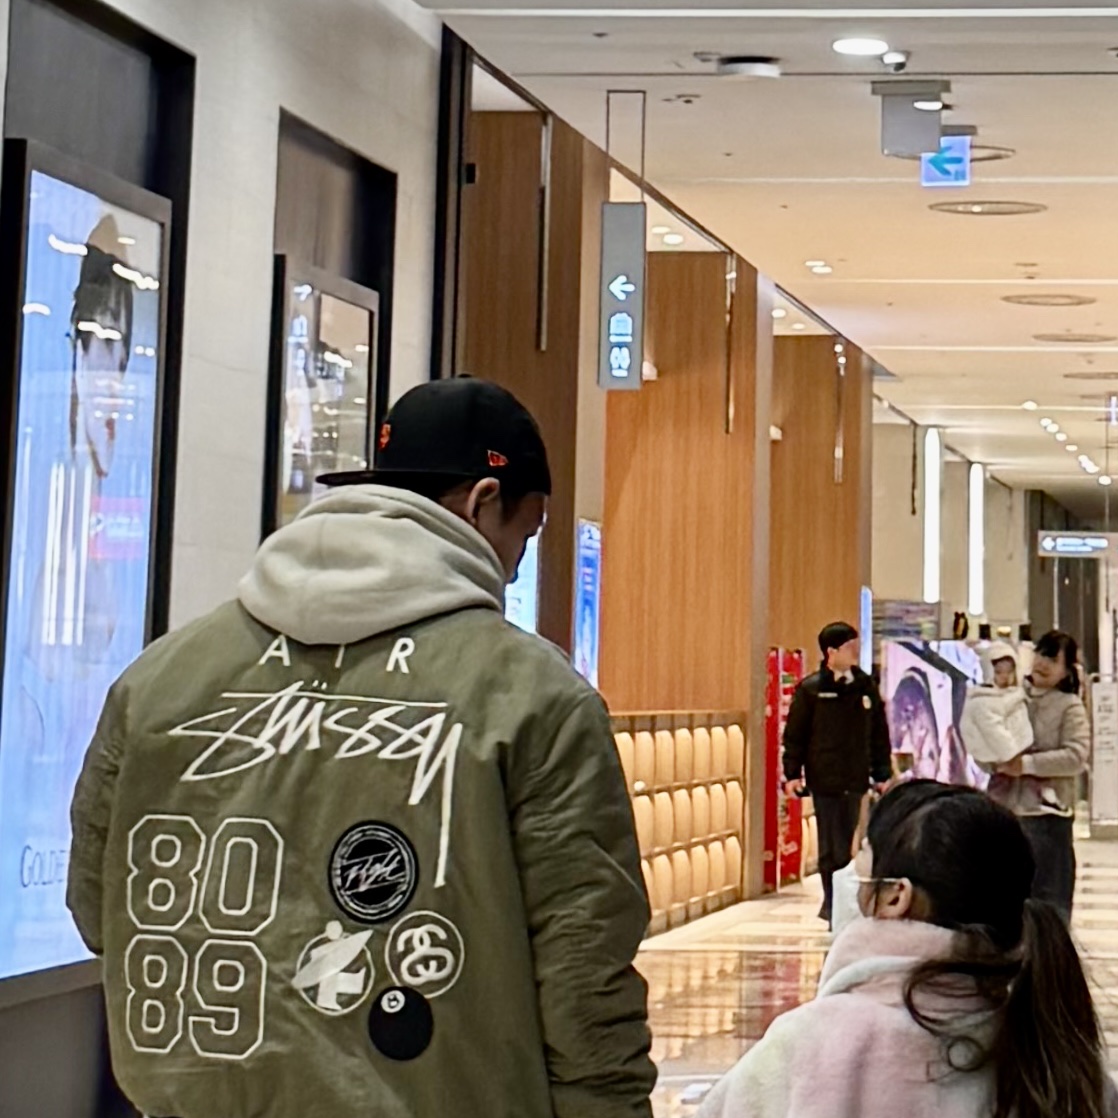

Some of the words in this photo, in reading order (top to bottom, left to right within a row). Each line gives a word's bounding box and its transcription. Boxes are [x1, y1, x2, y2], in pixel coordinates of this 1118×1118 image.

[259, 634, 415, 674] AIR
[127, 814, 284, 936] 80
[124, 934, 267, 1059] 89
